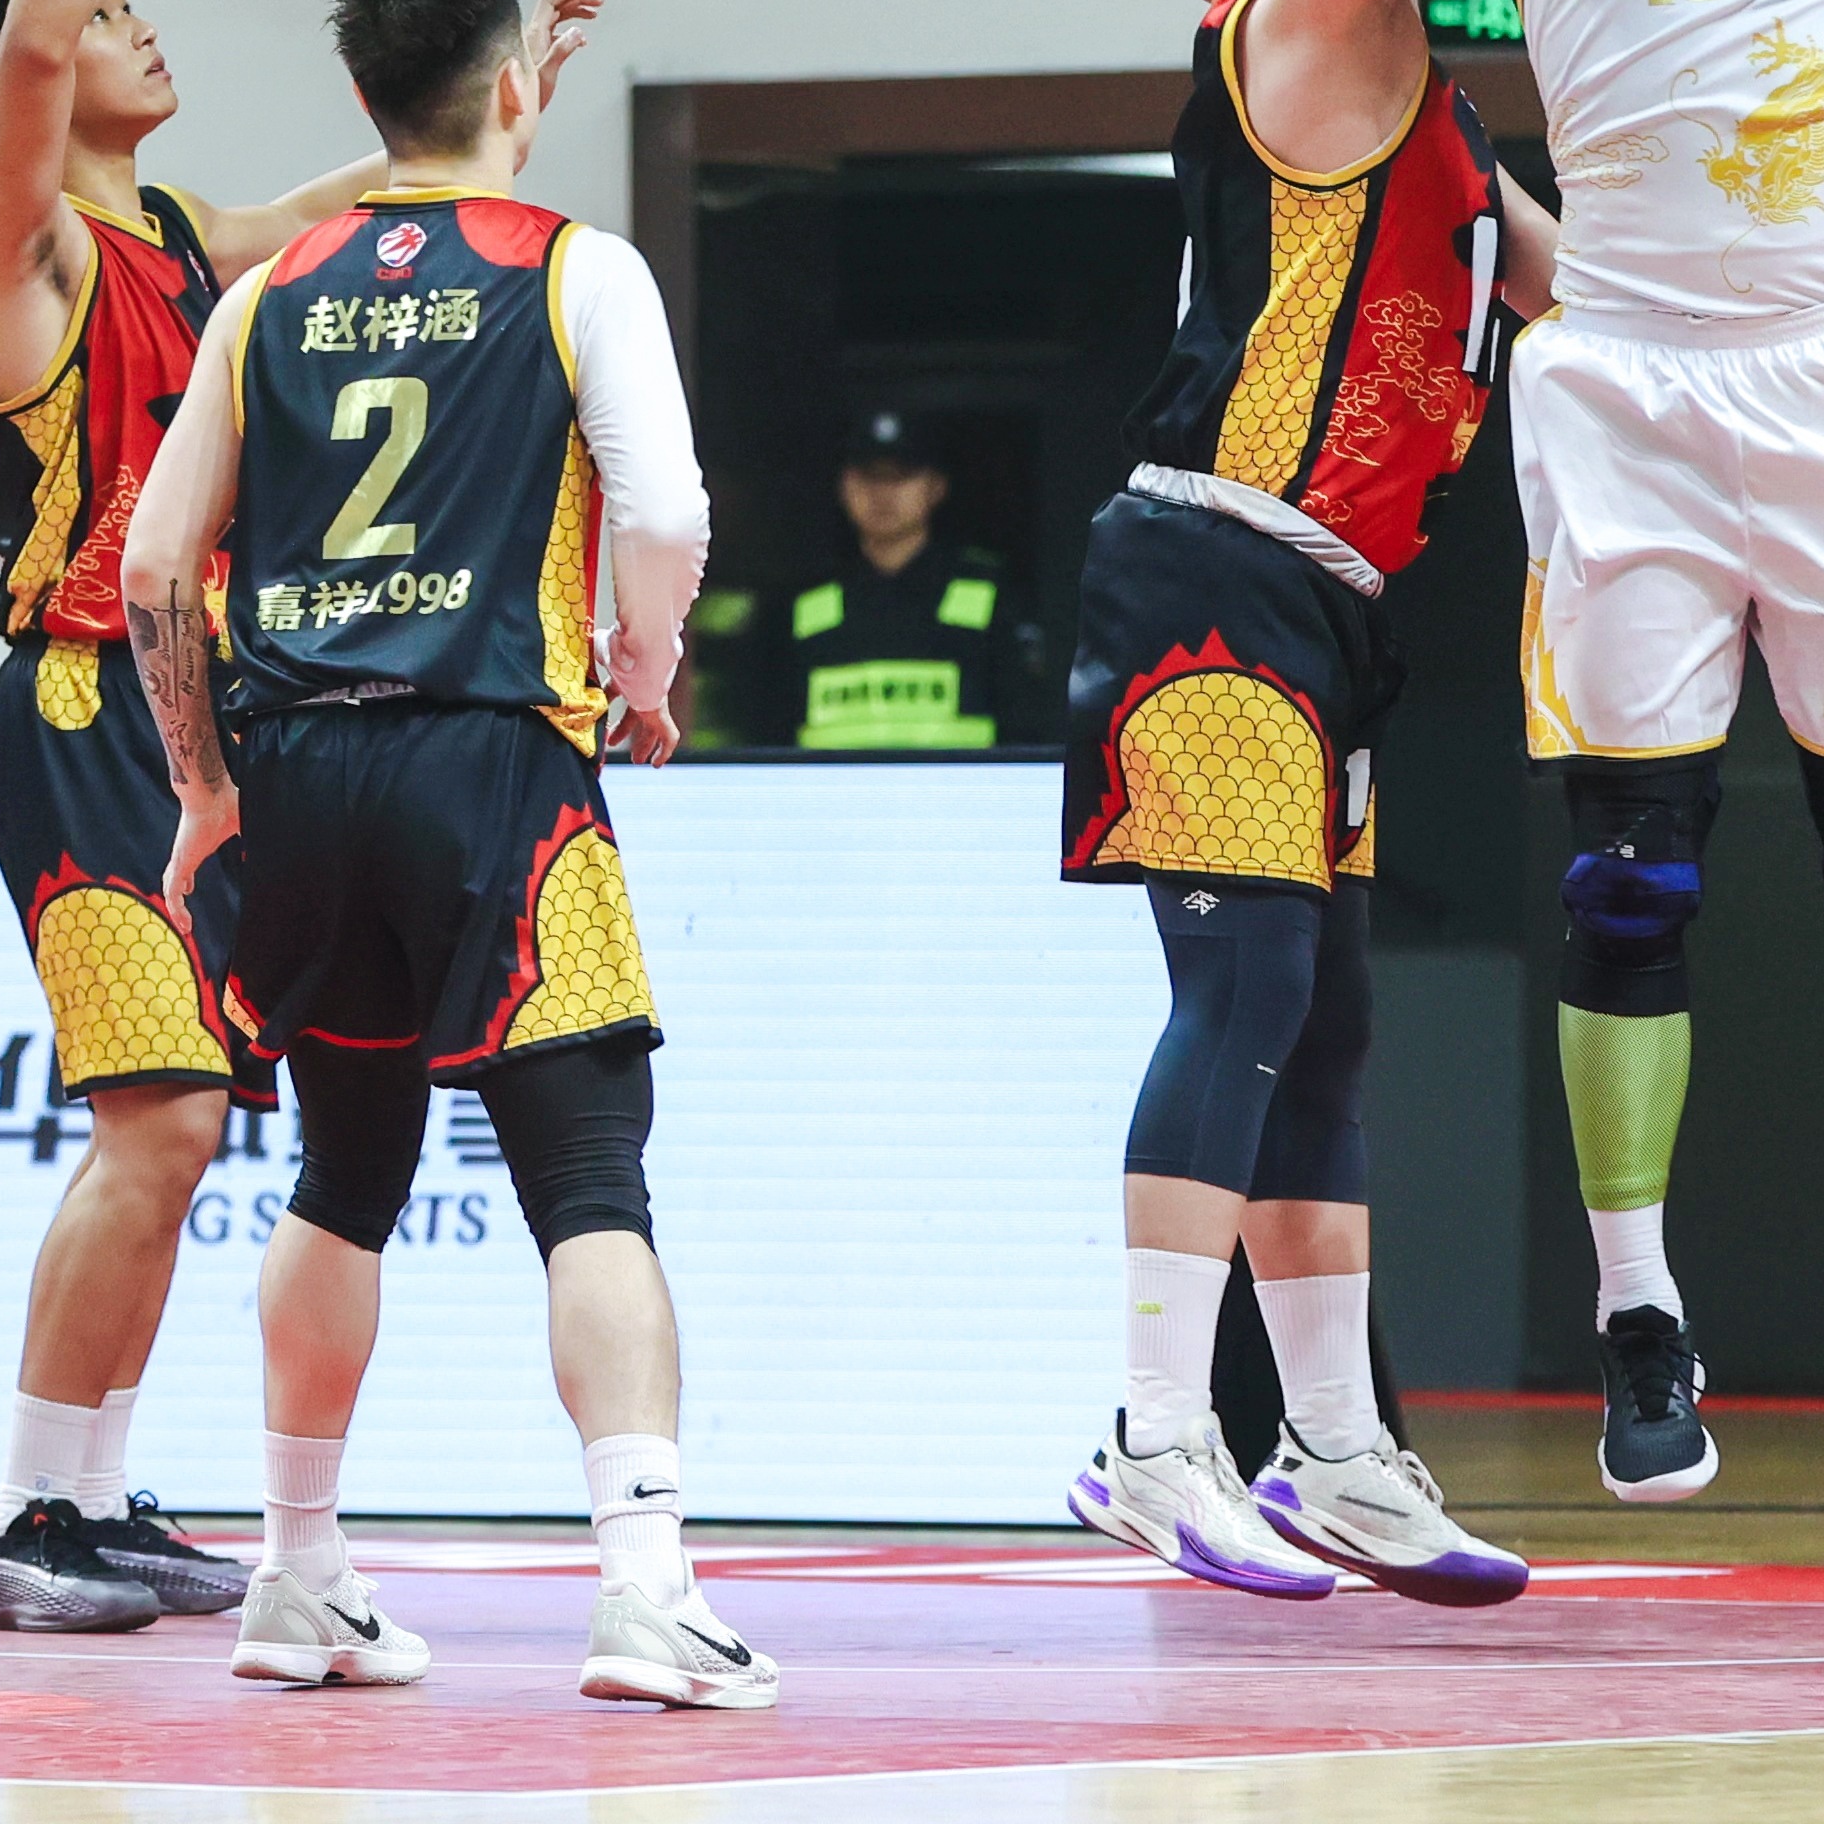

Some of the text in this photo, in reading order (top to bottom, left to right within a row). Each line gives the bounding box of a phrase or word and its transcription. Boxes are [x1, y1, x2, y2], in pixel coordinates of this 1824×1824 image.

[299, 288, 481, 354] 赵梓涵
[322, 376, 429, 561] 2
[256, 568, 473, 631] 嘉祥1998
